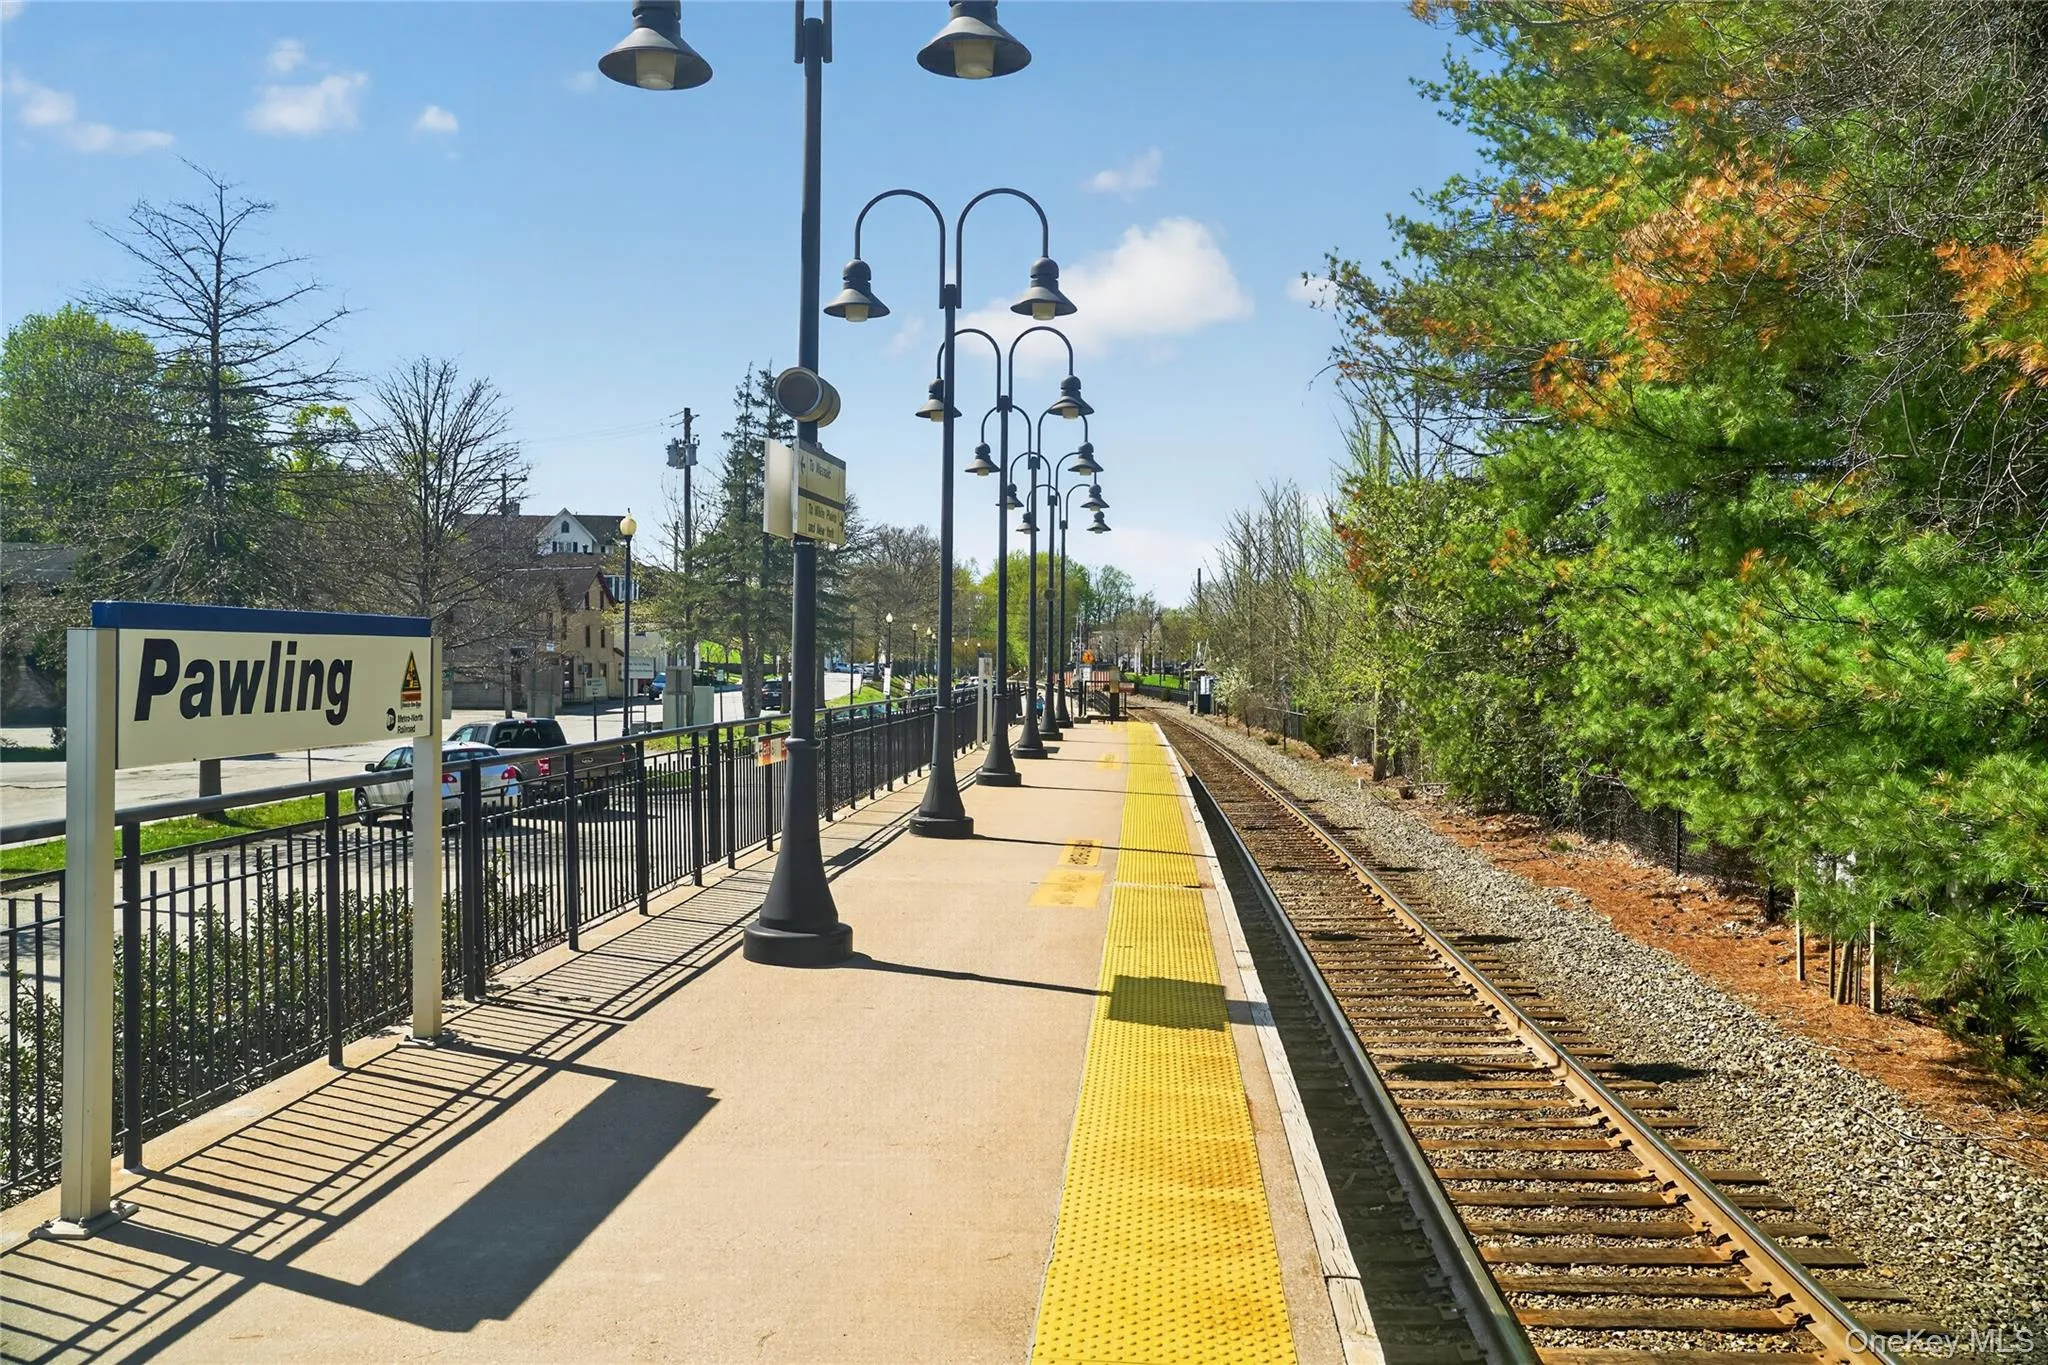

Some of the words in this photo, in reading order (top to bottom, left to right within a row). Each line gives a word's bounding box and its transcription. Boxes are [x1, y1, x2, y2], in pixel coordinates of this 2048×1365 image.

[134, 638, 353, 726] Pawling
[397, 713, 424, 723] Metro-North
[397, 725, 416, 734] Railroad
